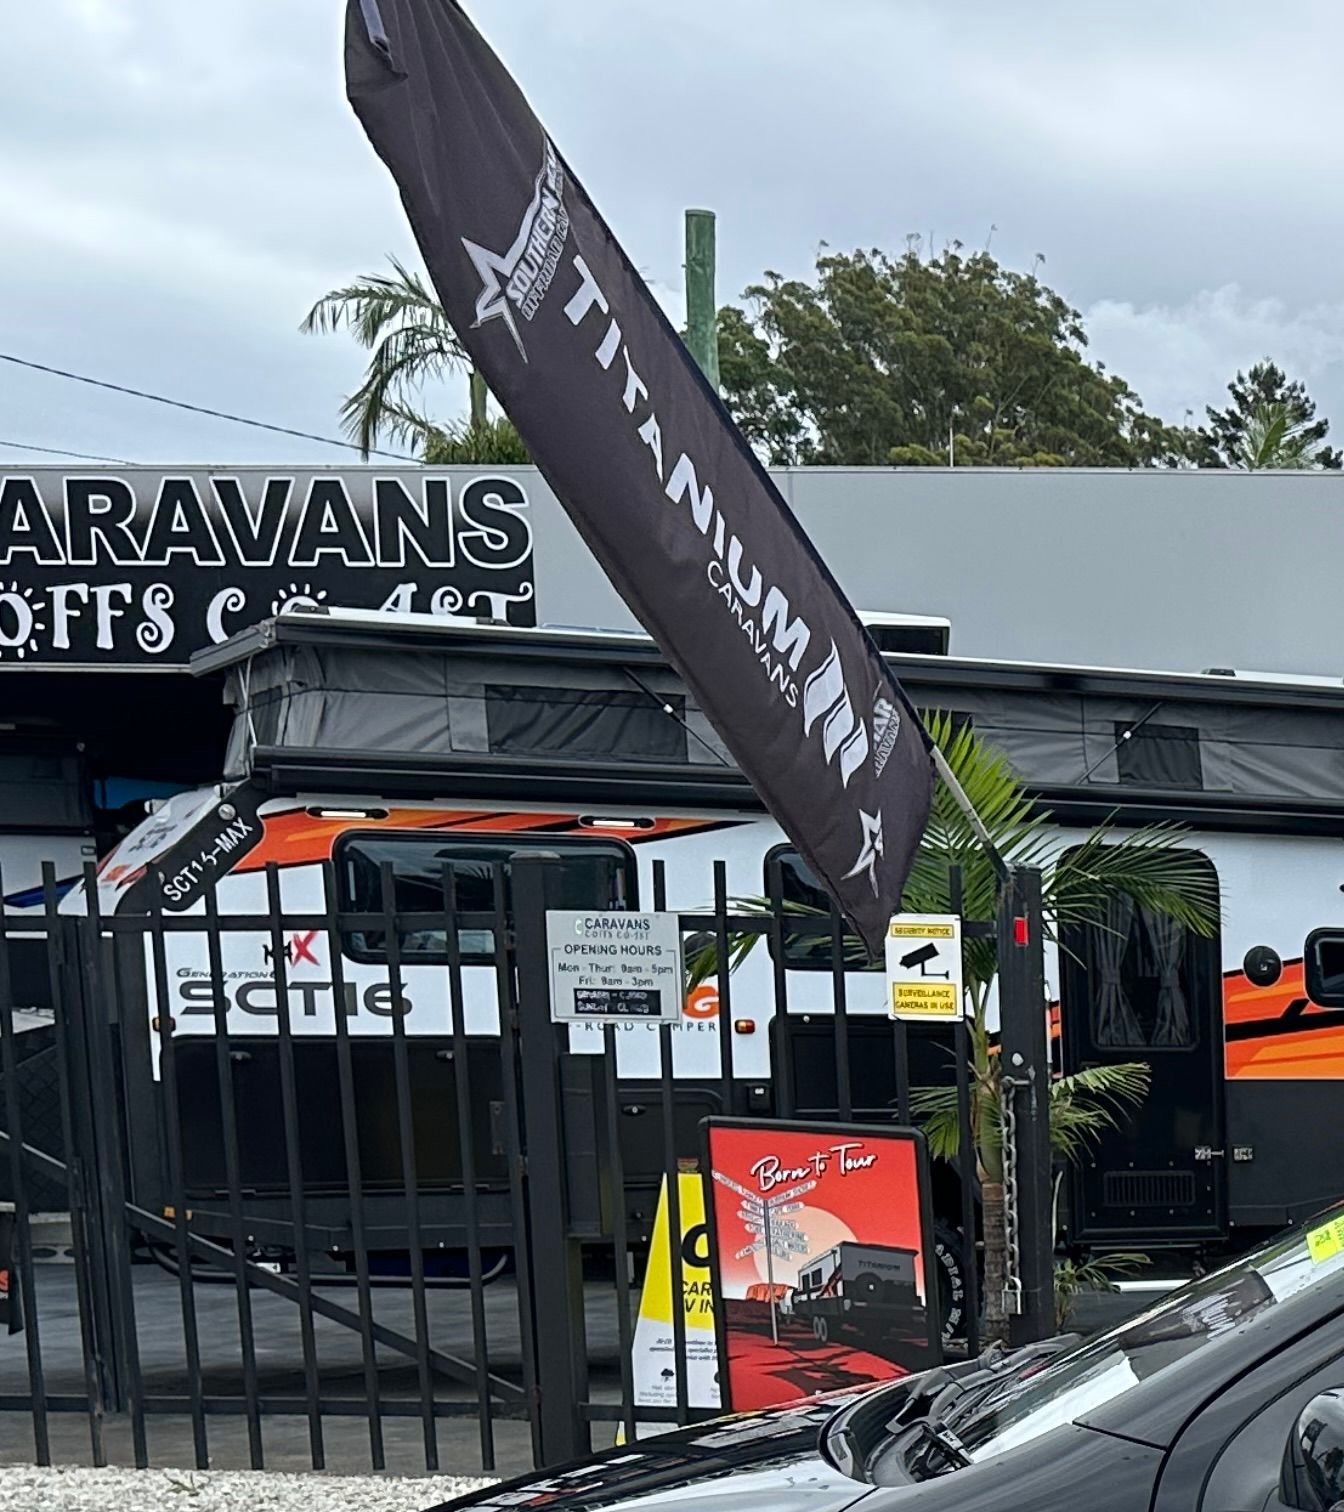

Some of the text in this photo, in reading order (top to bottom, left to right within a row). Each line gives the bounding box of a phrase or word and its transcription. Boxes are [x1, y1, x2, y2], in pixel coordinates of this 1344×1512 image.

[506, 187, 561, 308] SOUTHERN
[563, 254, 811, 672] TITANIUM
[706, 560, 799, 709] CARAVANS
[584, 917, 650, 931] CARAVANS
[558, 963, 579, 972] Mon
[652, 965, 673, 976] 5pm
[564, 944, 662, 956] OPENING HOURS
[751, 1155, 810, 1192] Born
[808, 1151, 831, 1176] to
[830, 1142, 878, 1176] Tour
